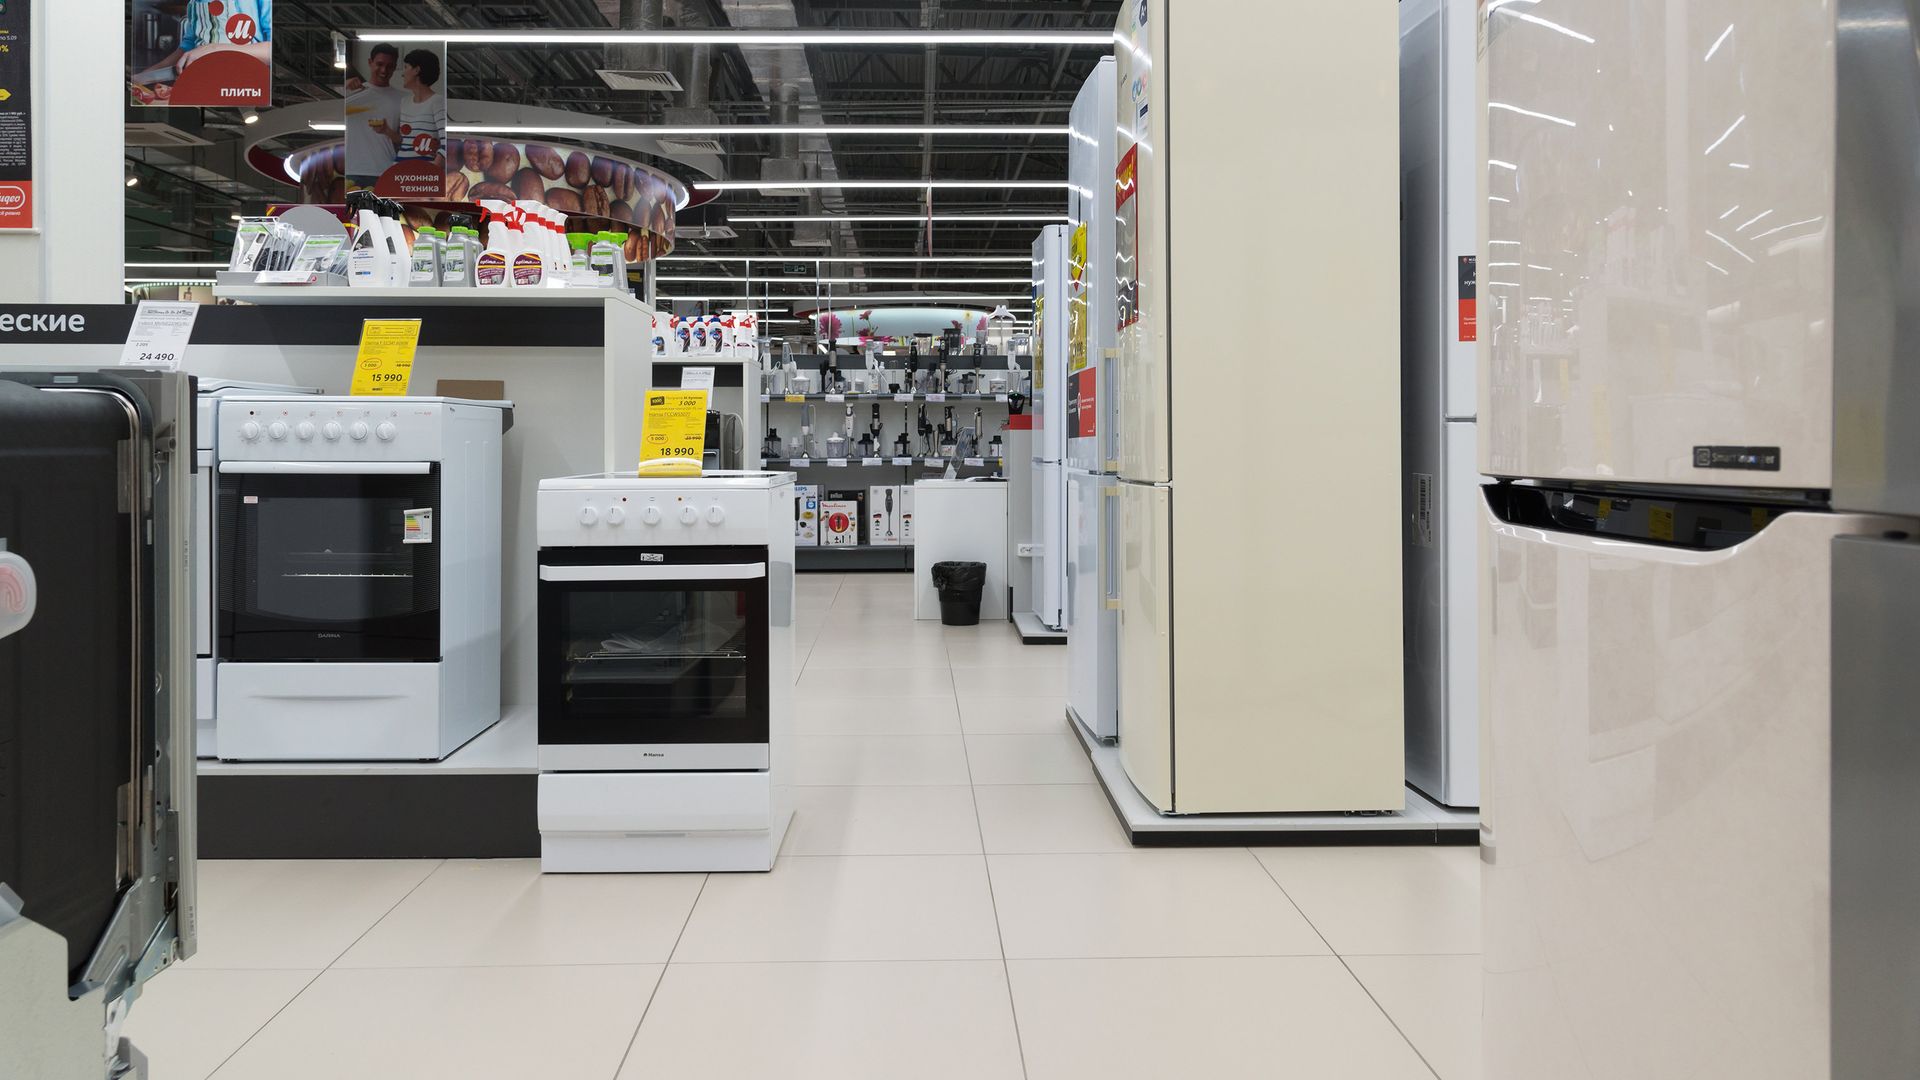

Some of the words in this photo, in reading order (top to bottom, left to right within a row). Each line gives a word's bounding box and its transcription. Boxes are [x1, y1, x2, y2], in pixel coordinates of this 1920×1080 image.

[220, 88, 261, 98] плиты
[394, 174, 440, 183] кухонная
[400, 185, 440, 193] техника
[0, 313, 86, 333] еские
[140, 352, 152, 361] 24
[154, 352, 175, 361] 490
[372, 373, 382, 382] 15
[384, 373, 403, 382] 990
[660, 448, 671, 456] 18
[674, 448, 694, 456] 990
